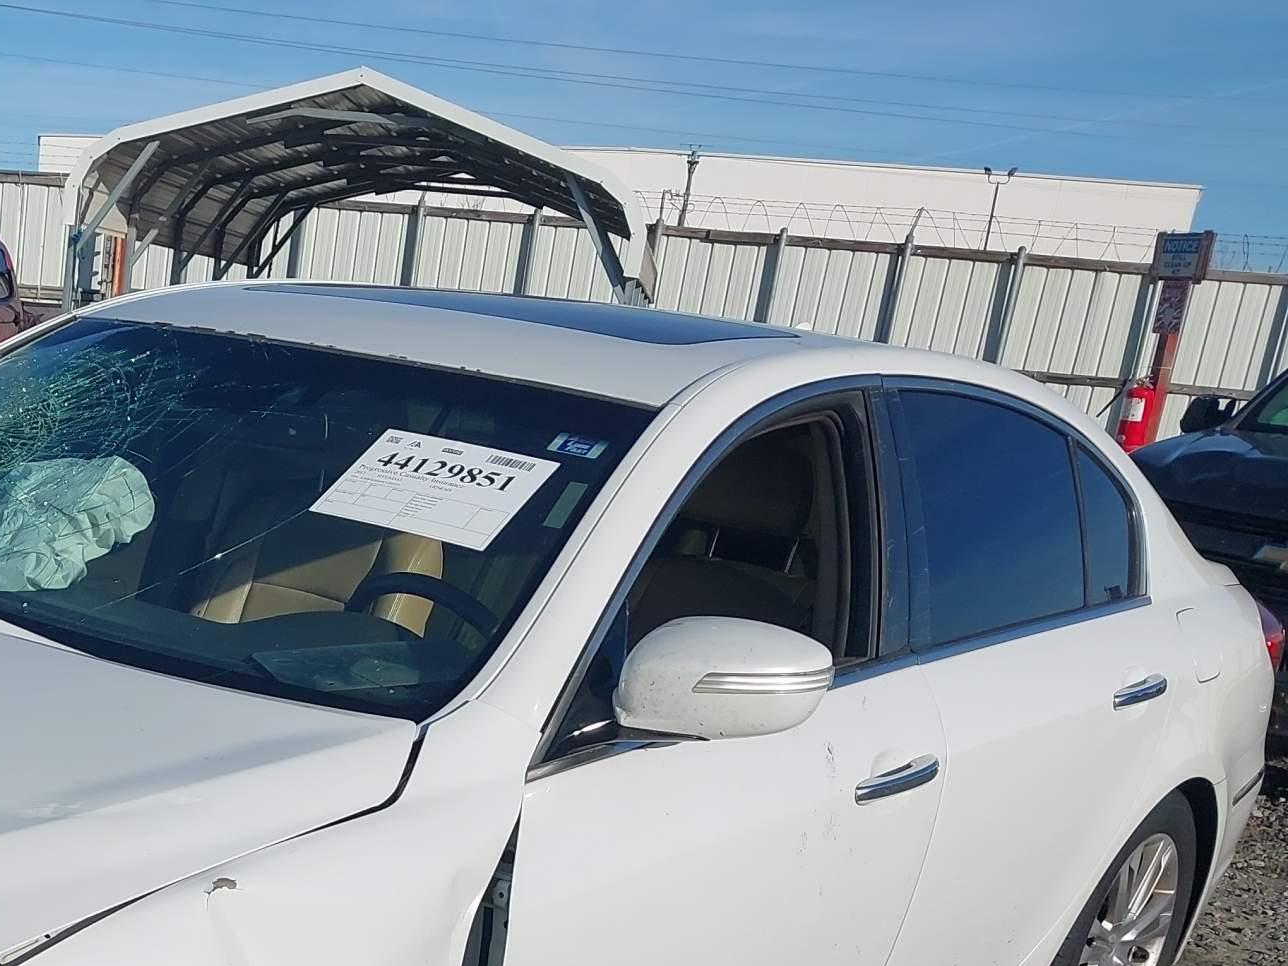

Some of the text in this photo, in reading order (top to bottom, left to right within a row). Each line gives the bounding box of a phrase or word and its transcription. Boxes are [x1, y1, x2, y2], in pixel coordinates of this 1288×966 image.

[1163, 239, 1200, 252] NOTICE
[359, 464, 399, 477] Progressive
[399, 471, 430, 482] Casualty
[431, 478, 466, 489] Insurance
[377, 452, 516, 492] 44129851
